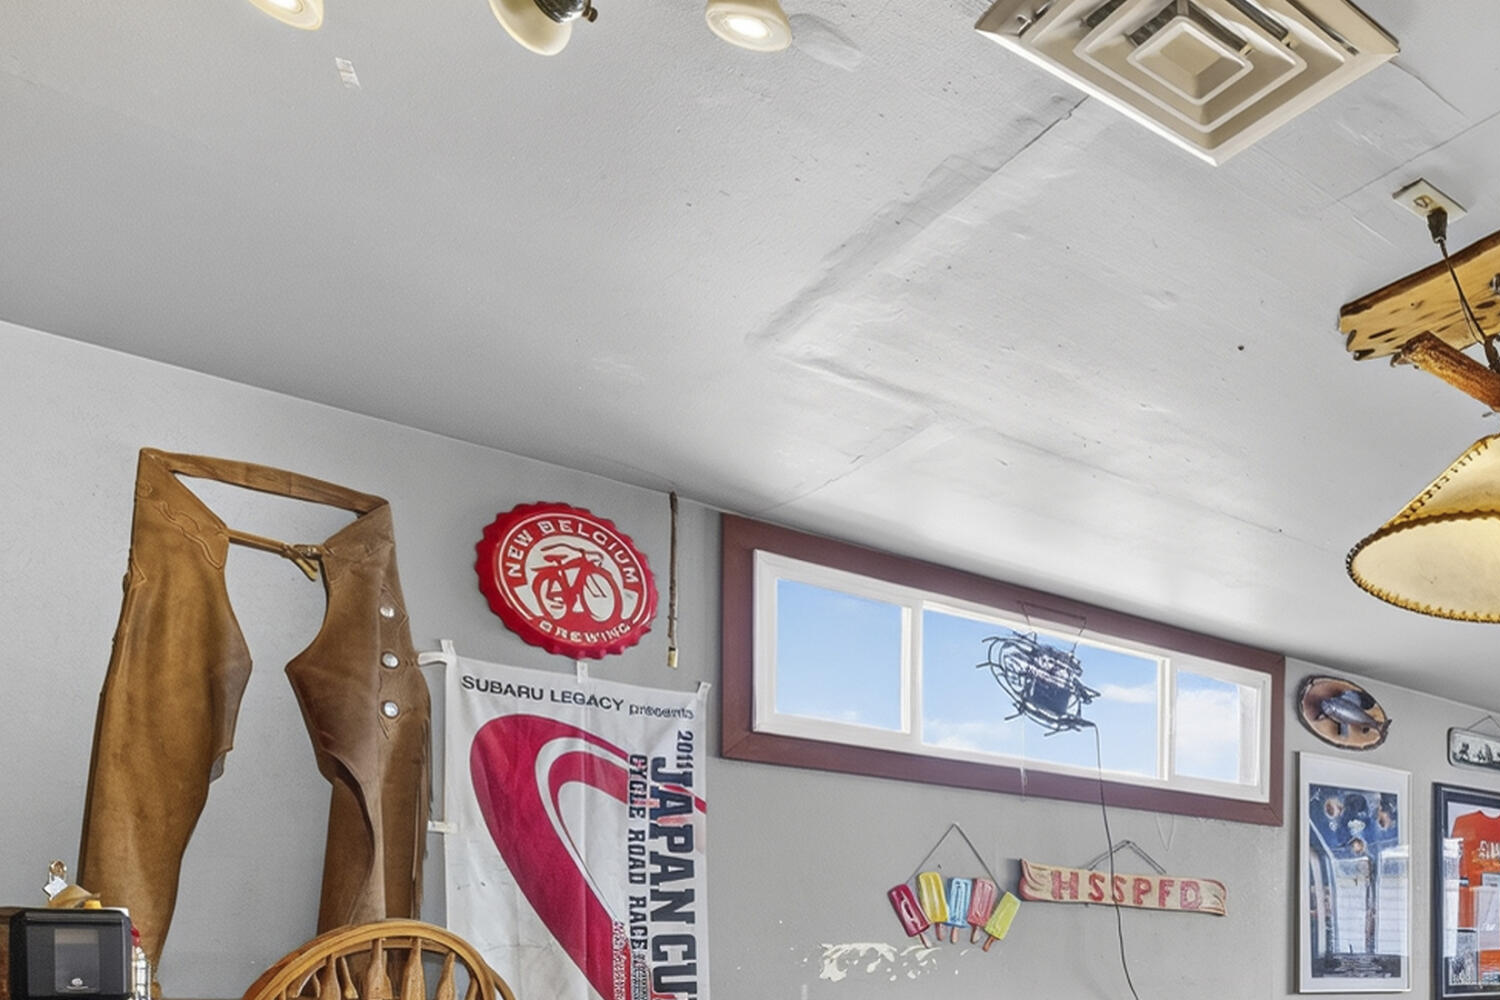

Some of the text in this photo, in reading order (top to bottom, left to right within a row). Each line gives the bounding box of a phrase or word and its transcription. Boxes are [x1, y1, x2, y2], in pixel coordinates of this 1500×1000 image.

[505, 519, 640, 584] NEW BELGIUM
[538, 620, 632, 644] BREWING
[461, 675, 545, 701] SUBARU
[550, 689, 625, 711] LEGACY
[676, 730, 694, 768] 2011
[628, 754, 648, 819] CYCLE
[628, 829, 647, 884] ROAD
[649, 757, 695, 924] JAPAN
[629, 896, 649, 950] RACE
